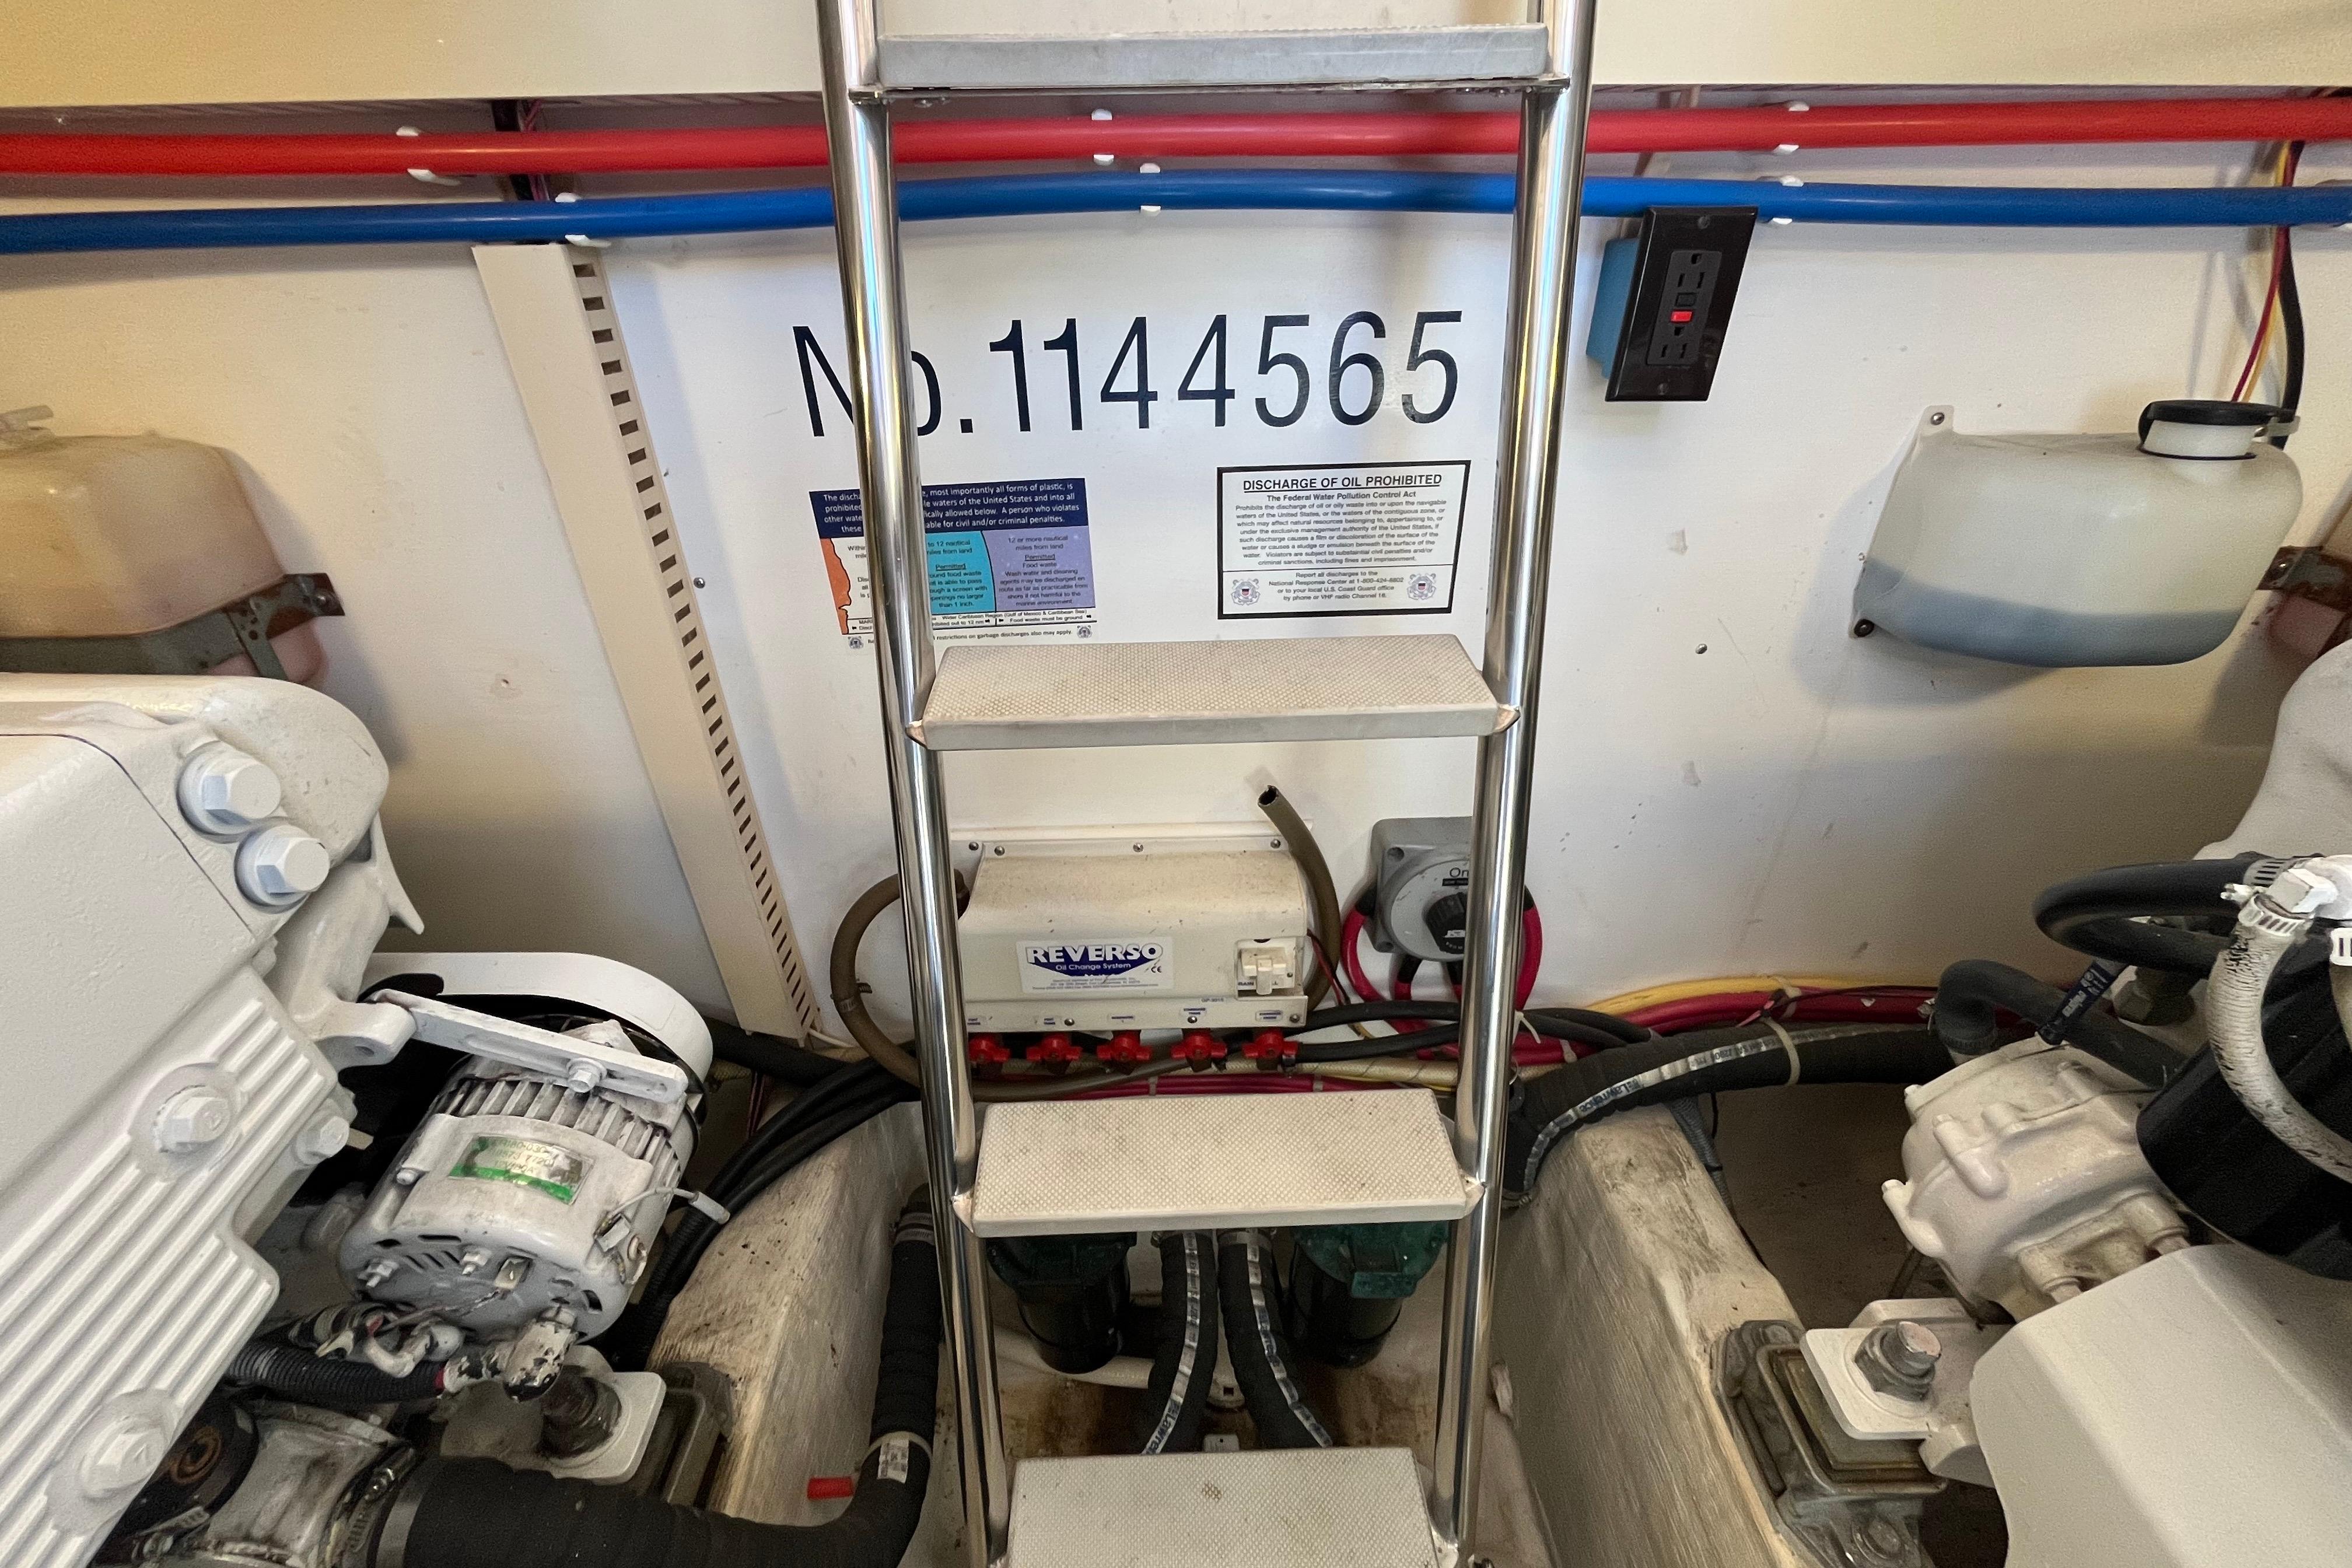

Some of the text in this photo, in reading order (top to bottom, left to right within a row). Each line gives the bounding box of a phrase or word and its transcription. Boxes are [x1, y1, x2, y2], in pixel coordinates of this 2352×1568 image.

[929, 488, 949, 496] most
[950, 485, 995, 496] importantly
[995, 485, 1005, 493] all
[1005, 484, 1028, 492] forms
[1038, 482, 1066, 492] plastic,
[1243, 474, 1442, 490] DISCHARGE OF OIL PROHIBITED
[822, 492, 859, 501] The disch
[931, 498, 957, 506] waters
[982, 495, 1008, 504] United
[1009, 494, 1032, 503] States
[1033, 494, 1048, 502] and
[944, 508, 973, 517] allowed
[973, 507, 998, 515] below.
[1007, 506, 1034, 514] person
[1034, 504, 1051, 512] who
[1051, 503, 1080, 512] violates
[822, 514, 844, 523] other
[924, 520, 942, 528] able
[971, 517, 997, 526] and/or
[997, 516, 1028, 524] criminal
[1028, 514, 1065, 524] penalties.
[840, 524, 862, 533] these
[1026, 943, 1163, 964] REVERSO
